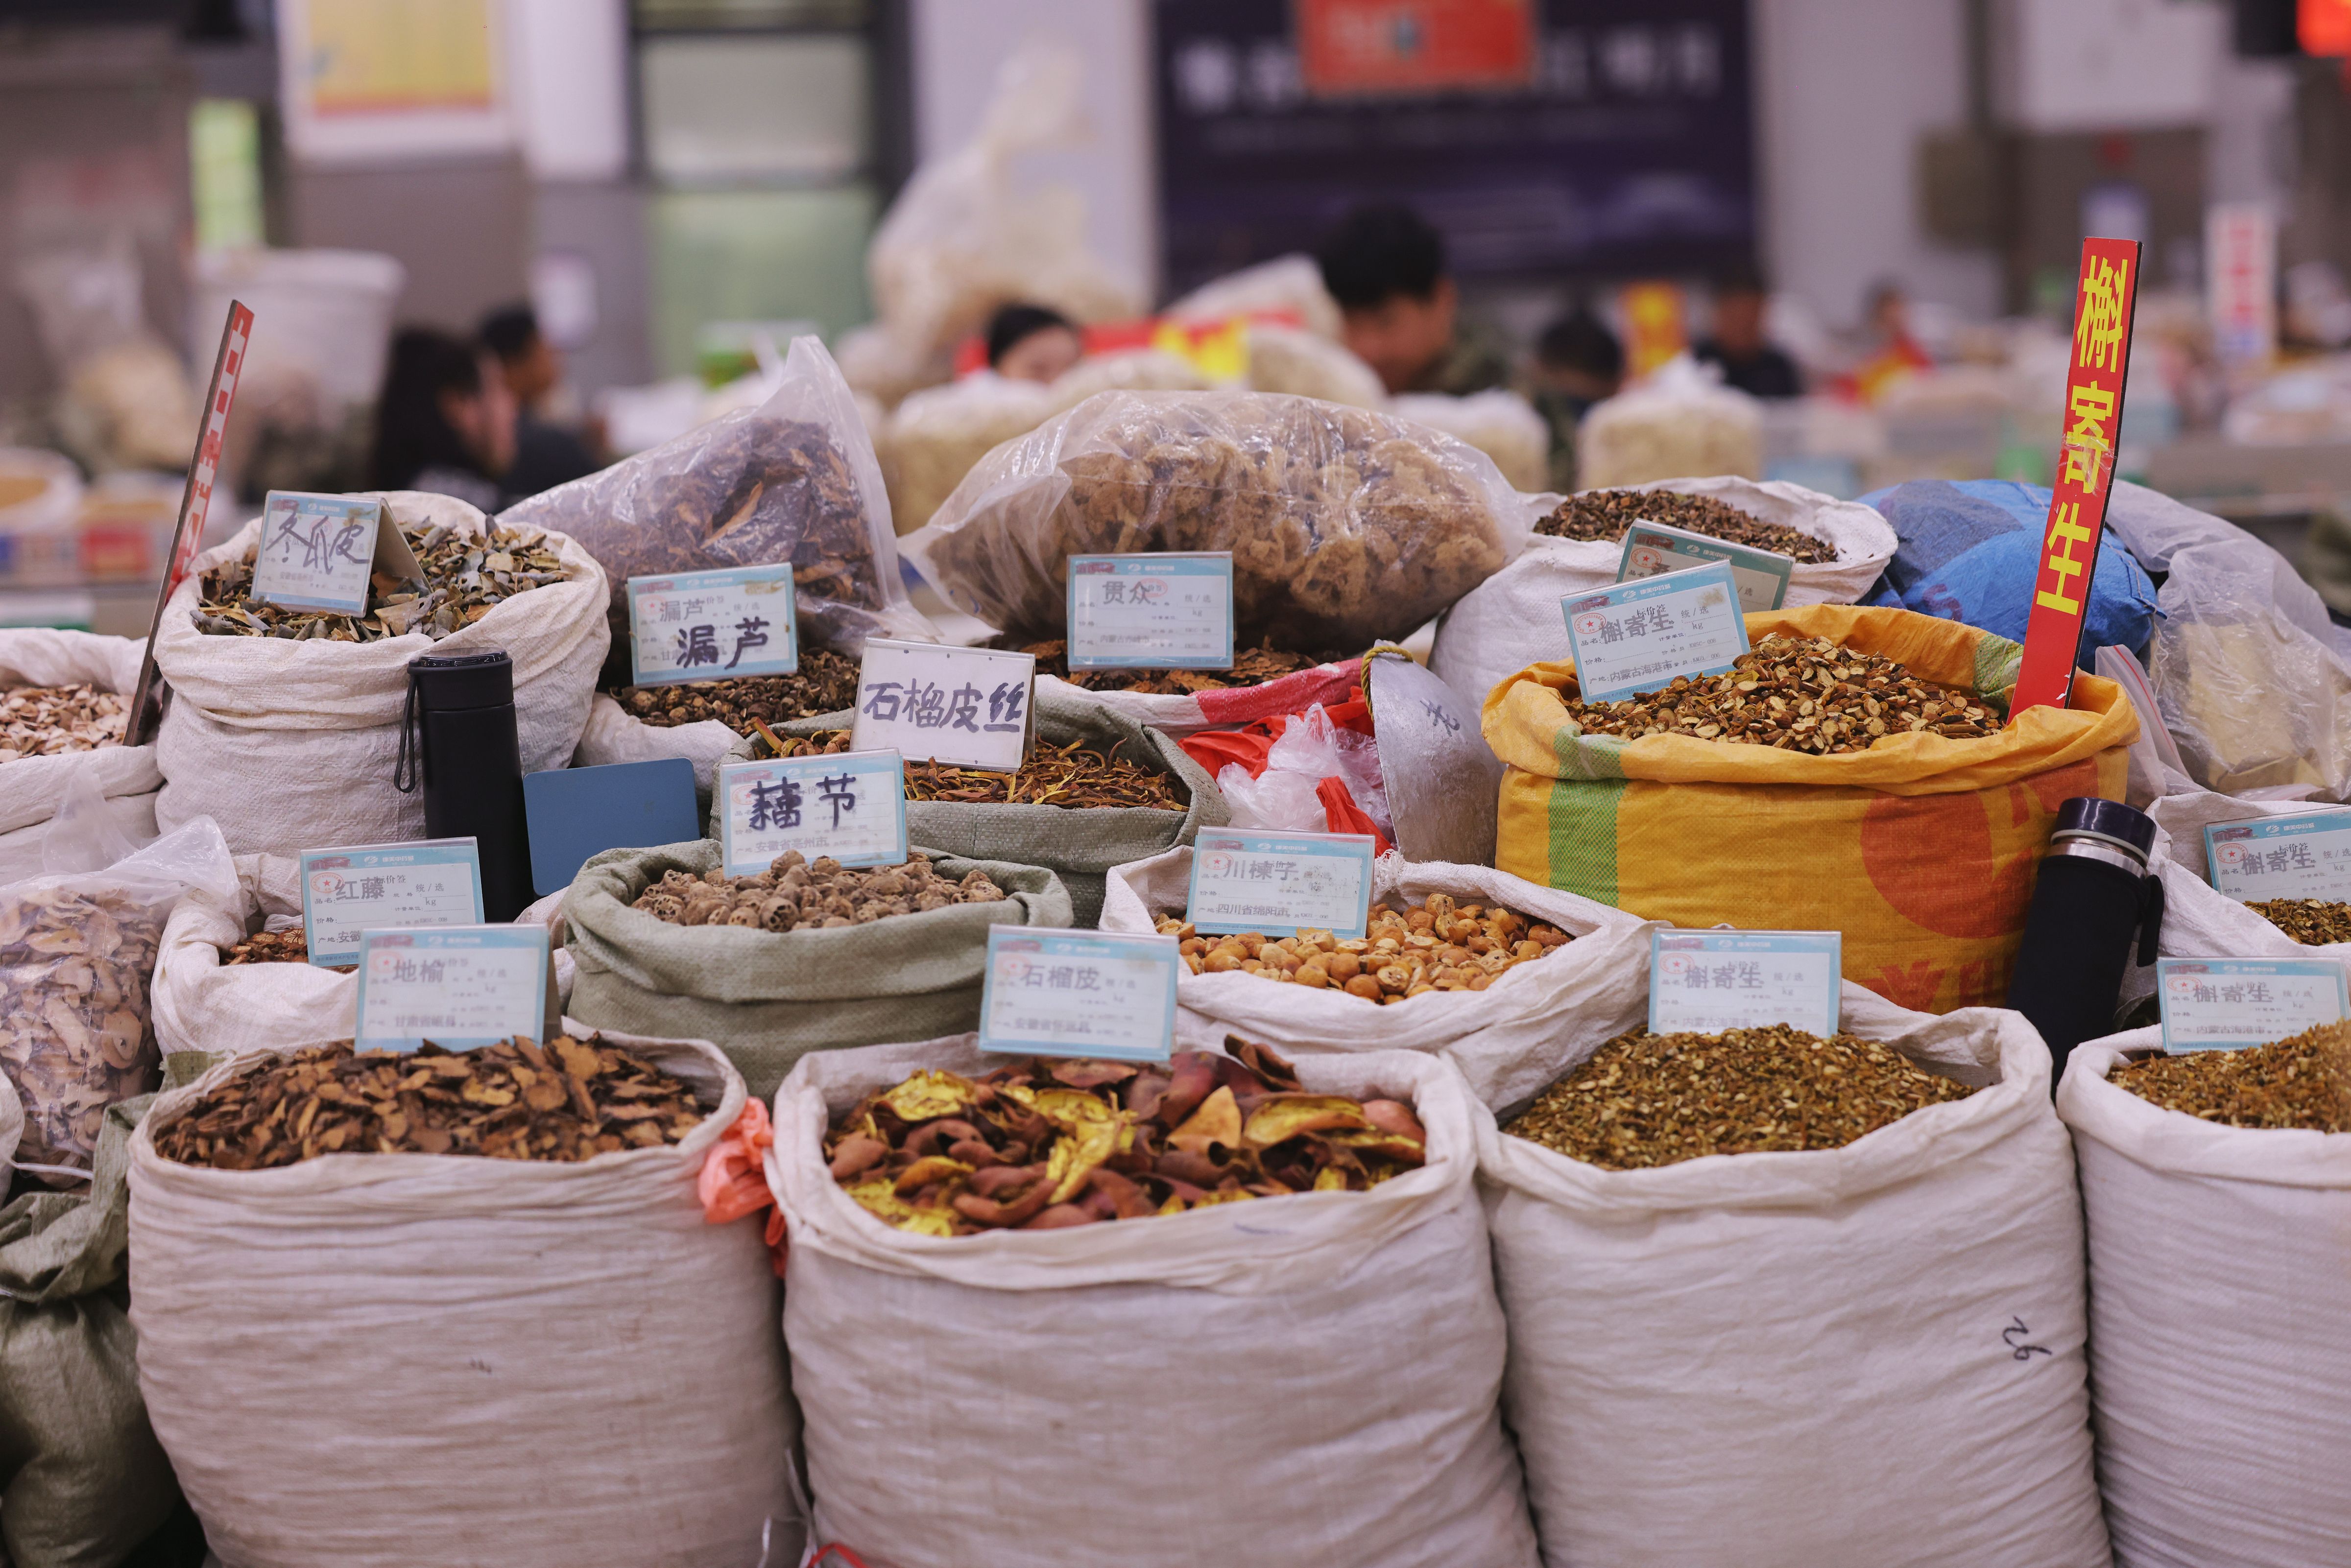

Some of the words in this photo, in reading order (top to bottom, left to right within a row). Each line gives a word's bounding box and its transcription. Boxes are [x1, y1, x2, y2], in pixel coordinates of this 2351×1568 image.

[2036, 255, 2129, 616] 槲寄生
[1102, 580, 1151, 605] 贯众
[660, 598, 705, 622] 漏芦
[1599, 610, 1674, 644] 槲寄生
[676, 616, 770, 670] 漏芦
[863, 678, 1025, 733] 石榴皮丝
[1223, 860, 1299, 881] 川楝子
[2241, 850, 2315, 876] 槲寄生
[335, 877, 385, 901] 红藤
[426, 897, 436, 906] kg
[1218, 903, 1289, 916] 四川省绵阳市
[392, 958, 446, 983] 地榆
[1020, 964, 1101, 991] 石榴皮
[1684, 966, 1762, 989] 槲寄生
[2193, 984, 2272, 1003] 槲寄生
